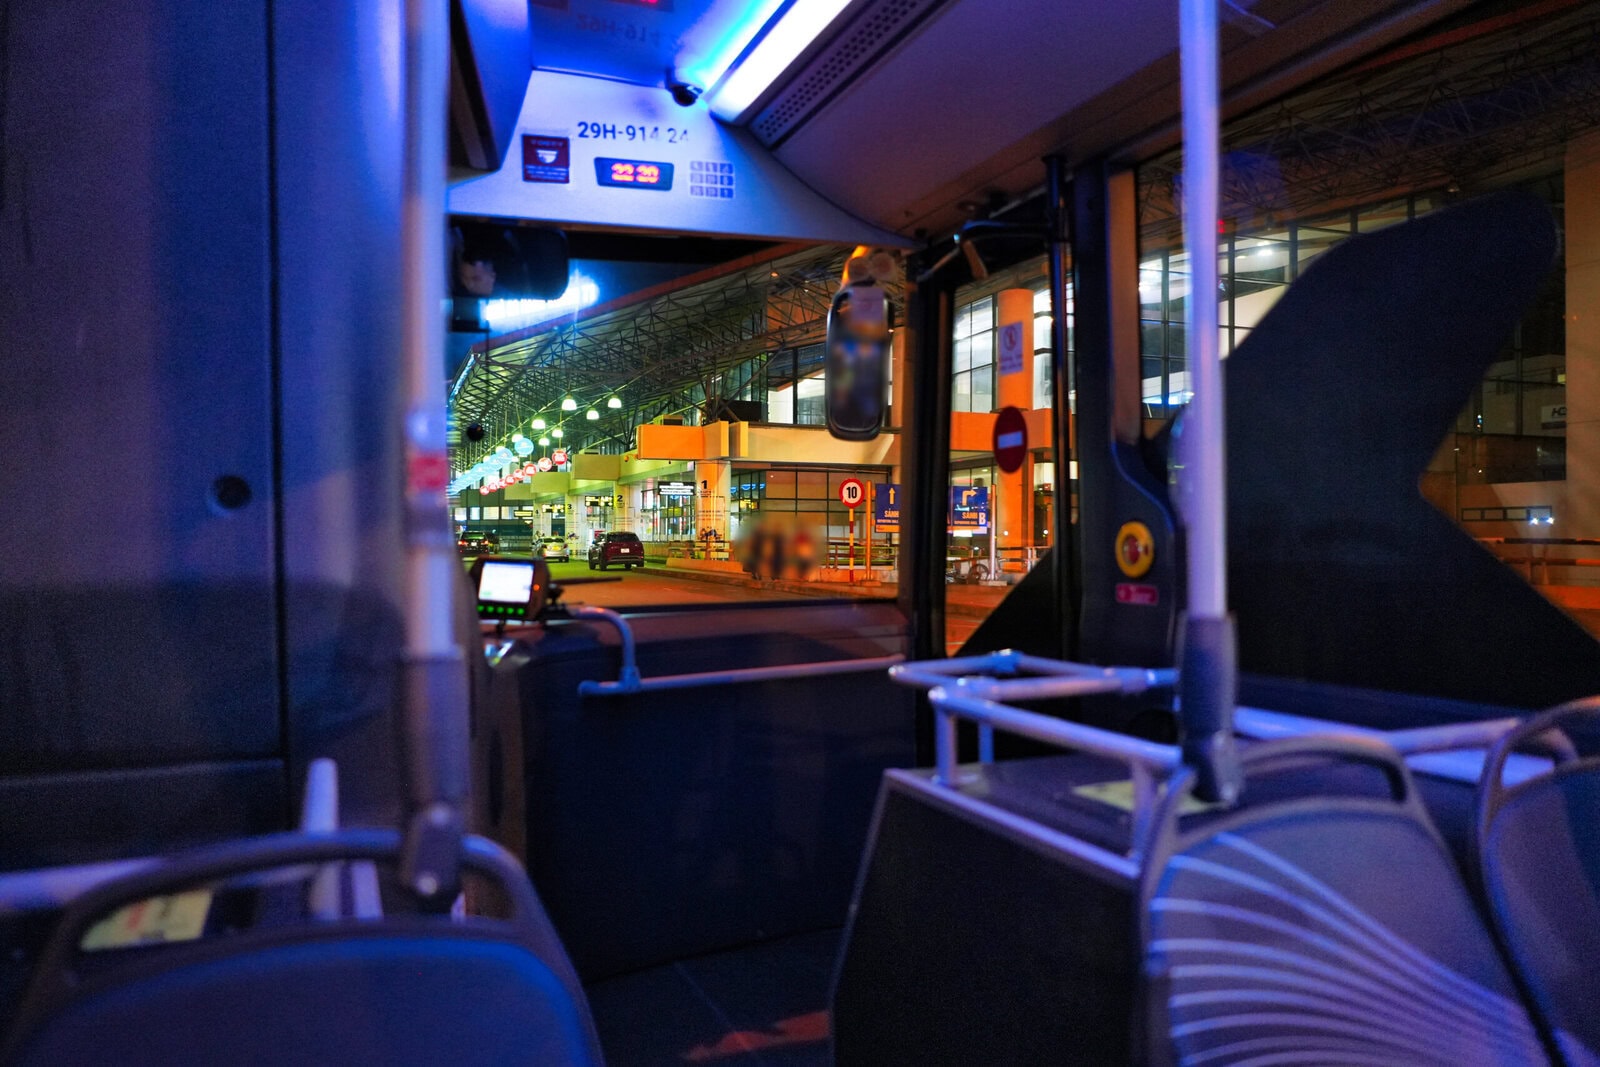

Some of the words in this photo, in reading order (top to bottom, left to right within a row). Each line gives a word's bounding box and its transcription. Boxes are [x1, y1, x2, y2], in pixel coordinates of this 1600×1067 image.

[701, 479, 708, 489] 1
[846, 486, 858, 499] 10
[616, 494, 623, 503] 2
[978, 512, 987, 525] B
